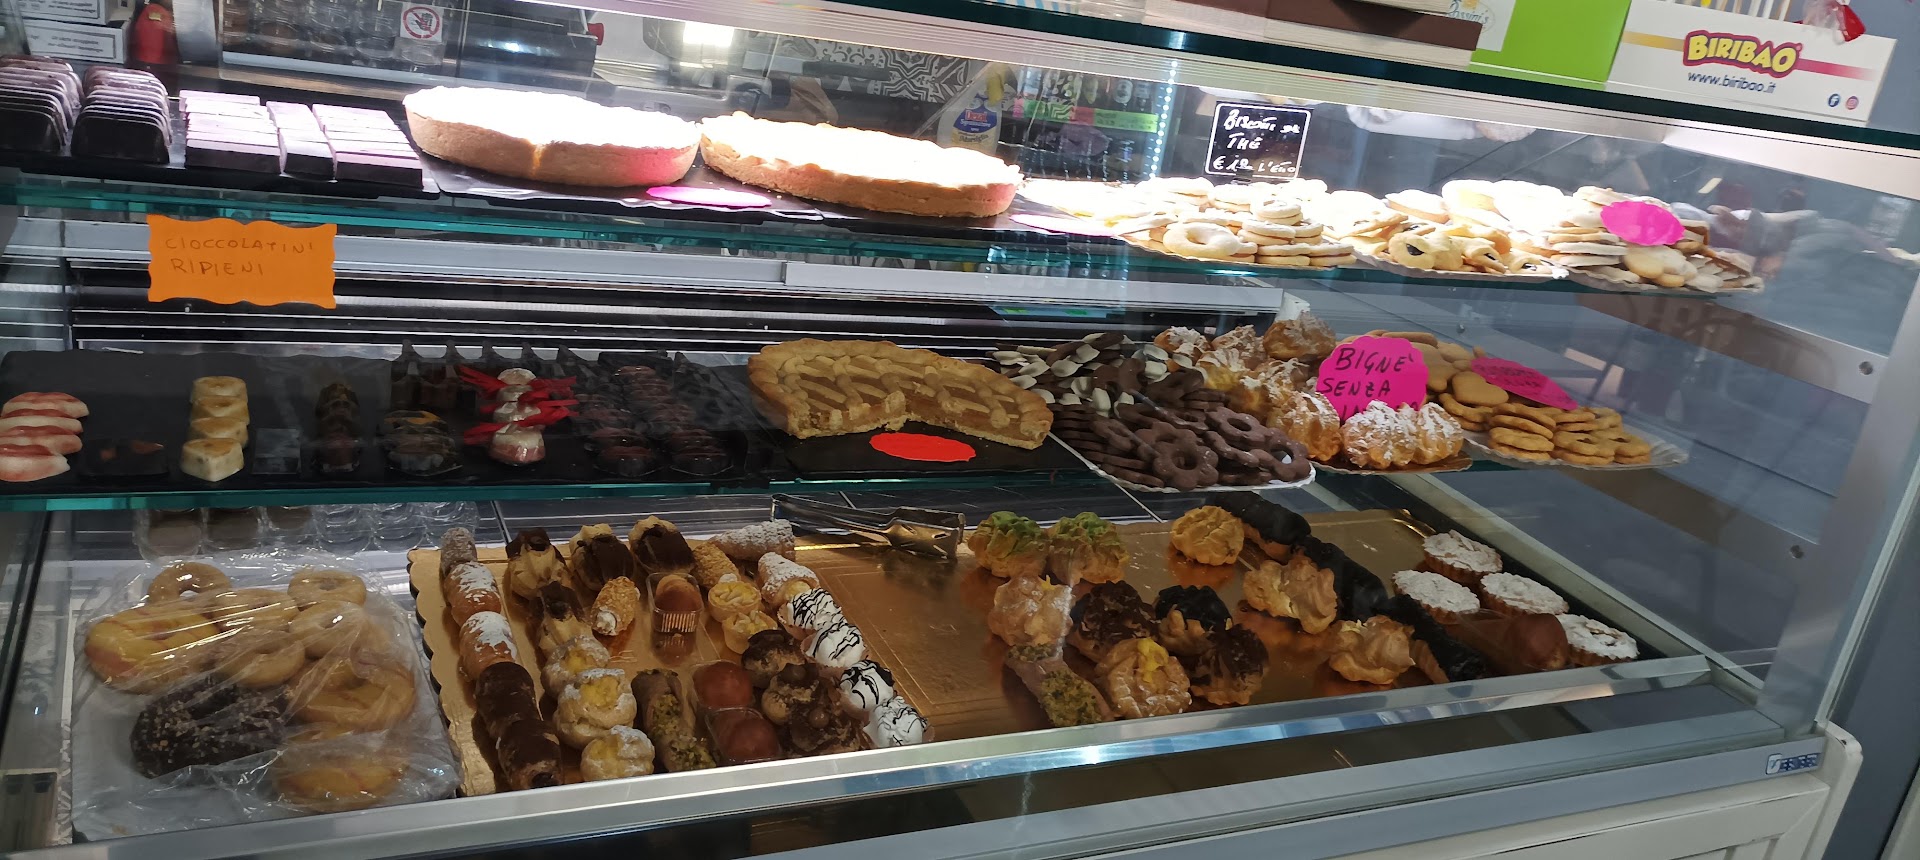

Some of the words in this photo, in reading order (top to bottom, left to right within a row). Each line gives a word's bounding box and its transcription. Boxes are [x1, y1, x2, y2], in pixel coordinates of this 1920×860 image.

[1687, 34, 1797, 74] BIRIBAO
[1687, 71, 1777, 94] www.biribao.it
[165, 237, 313, 254] CIOCCOLATINI
[170, 258, 264, 276] RIPIENI
[1317, 377, 1391, 398] SENZA
